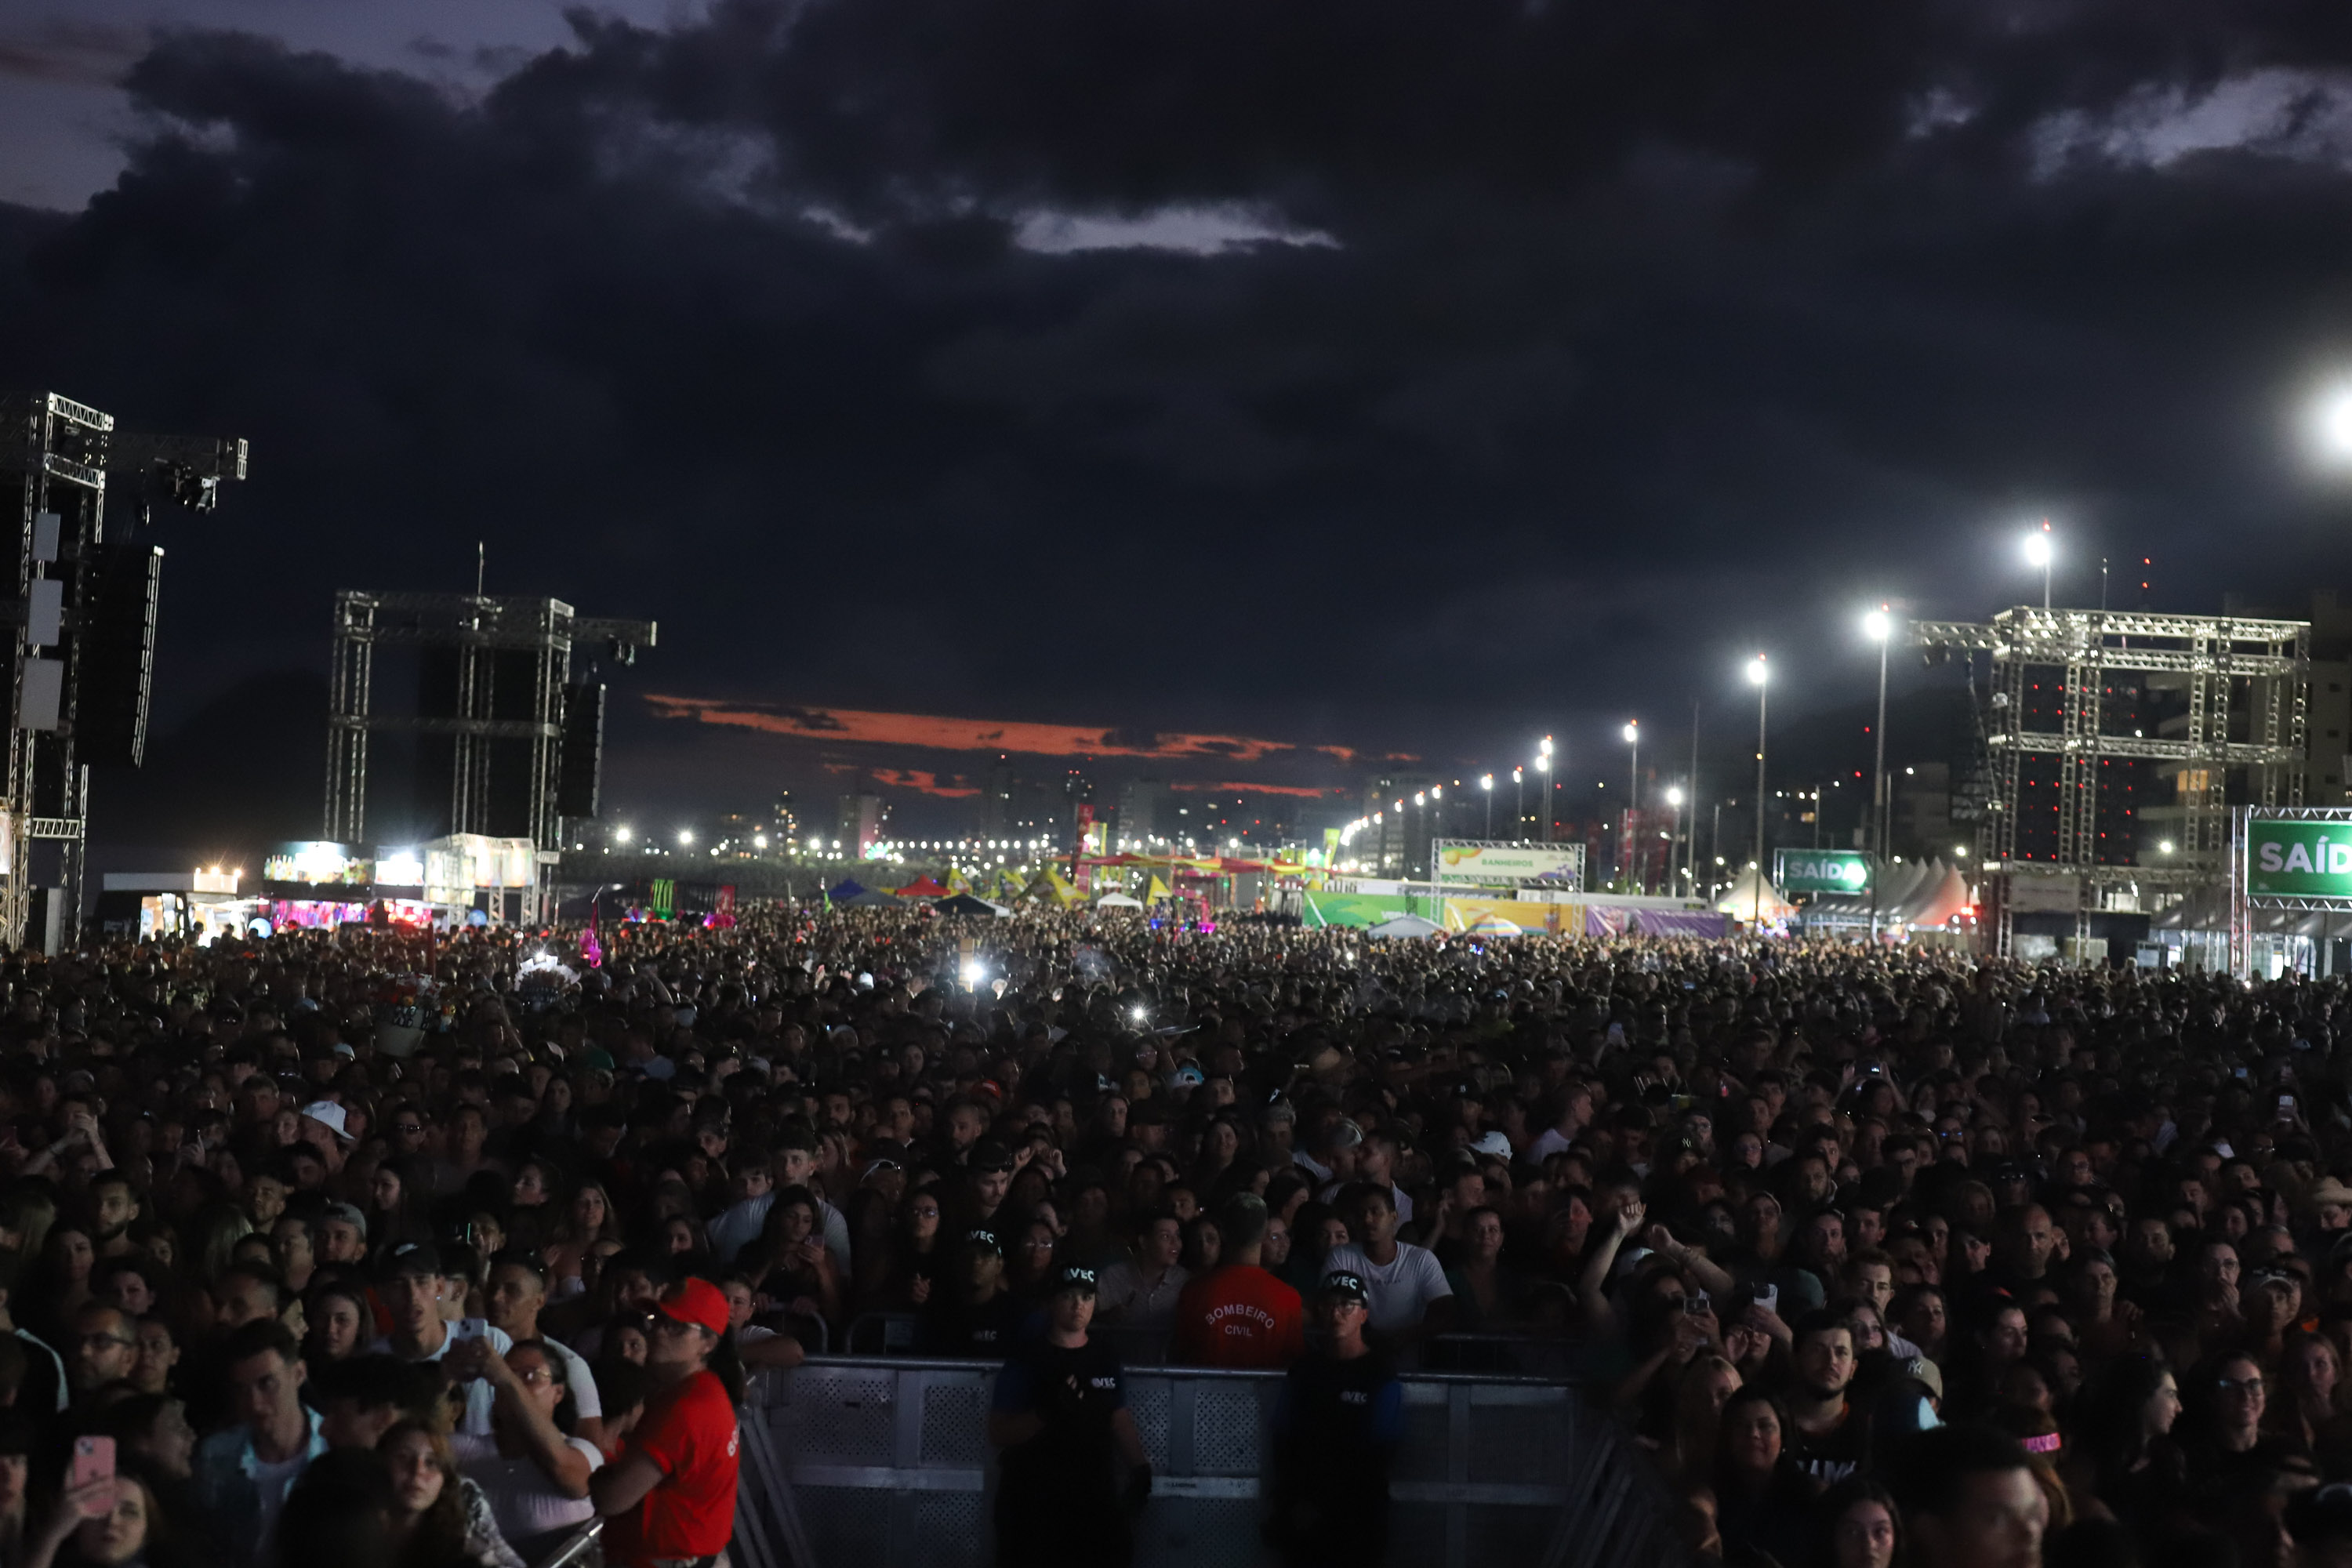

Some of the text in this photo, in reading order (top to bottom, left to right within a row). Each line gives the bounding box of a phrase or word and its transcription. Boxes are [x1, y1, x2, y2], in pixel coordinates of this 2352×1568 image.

[1482, 858, 1534, 868] BANHEIROS
[1069, 1267, 1095, 1283] VEC
[1331, 1276, 1358, 1290] VEC
[1205, 1304, 1275, 1329] BOMBEIRO
[1225, 1324, 1253, 1336] CIVIL
